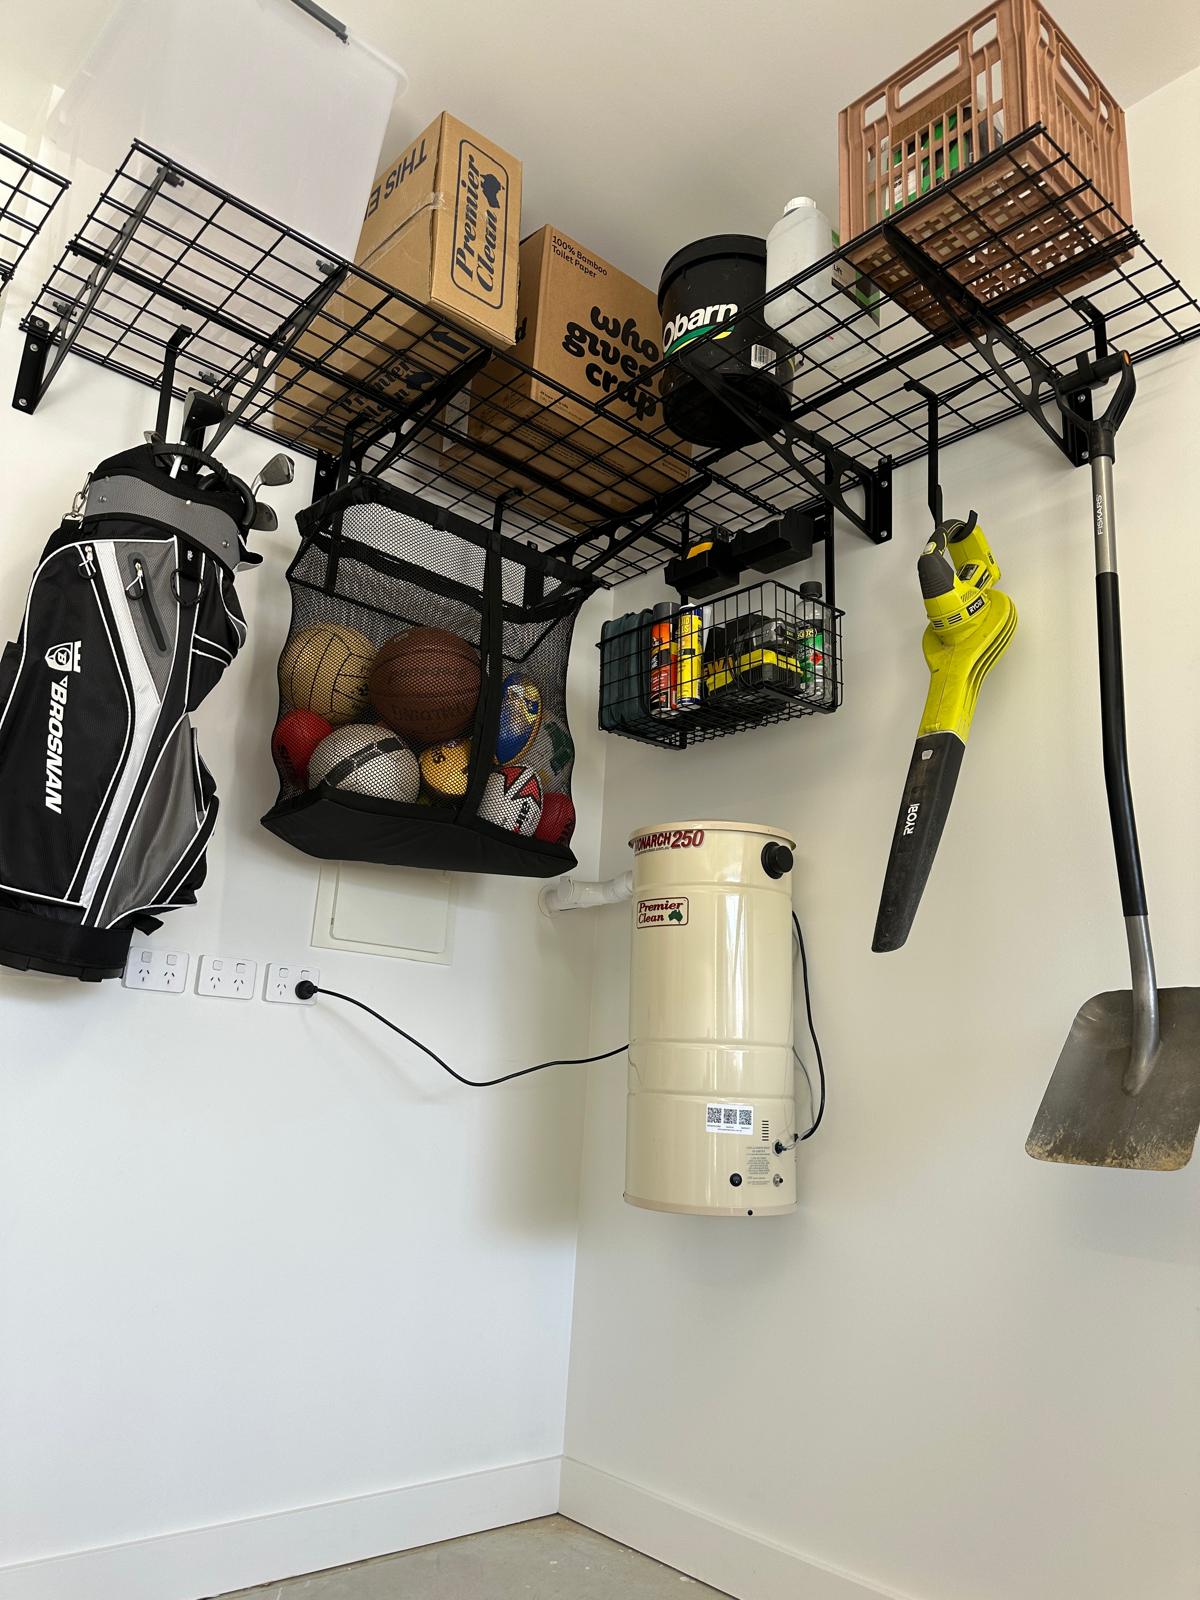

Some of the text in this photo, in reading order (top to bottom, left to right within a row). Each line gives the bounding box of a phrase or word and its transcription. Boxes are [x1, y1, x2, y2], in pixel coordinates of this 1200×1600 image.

[384, 138, 427, 199] THIS
[456, 154, 480, 282] Premier
[476, 209, 498, 292] Clean
[552, 235, 608, 276] 100% Bamboo
[552, 244, 597, 278] Toilet Paper
[590, 306, 660, 362] who
[562, 322, 653, 388] gives
[585, 362, 657, 422] crap
[1095, 494, 1104, 535] FISKARS
[968, 598, 984, 613] RYOBI
[45, 681, 68, 815] BROSNAN
[671, 829, 705, 849] 250
[903, 803, 921, 836] RYOBI
[638, 900, 684, 914] Premier
[638, 913, 665, 924] Clean
